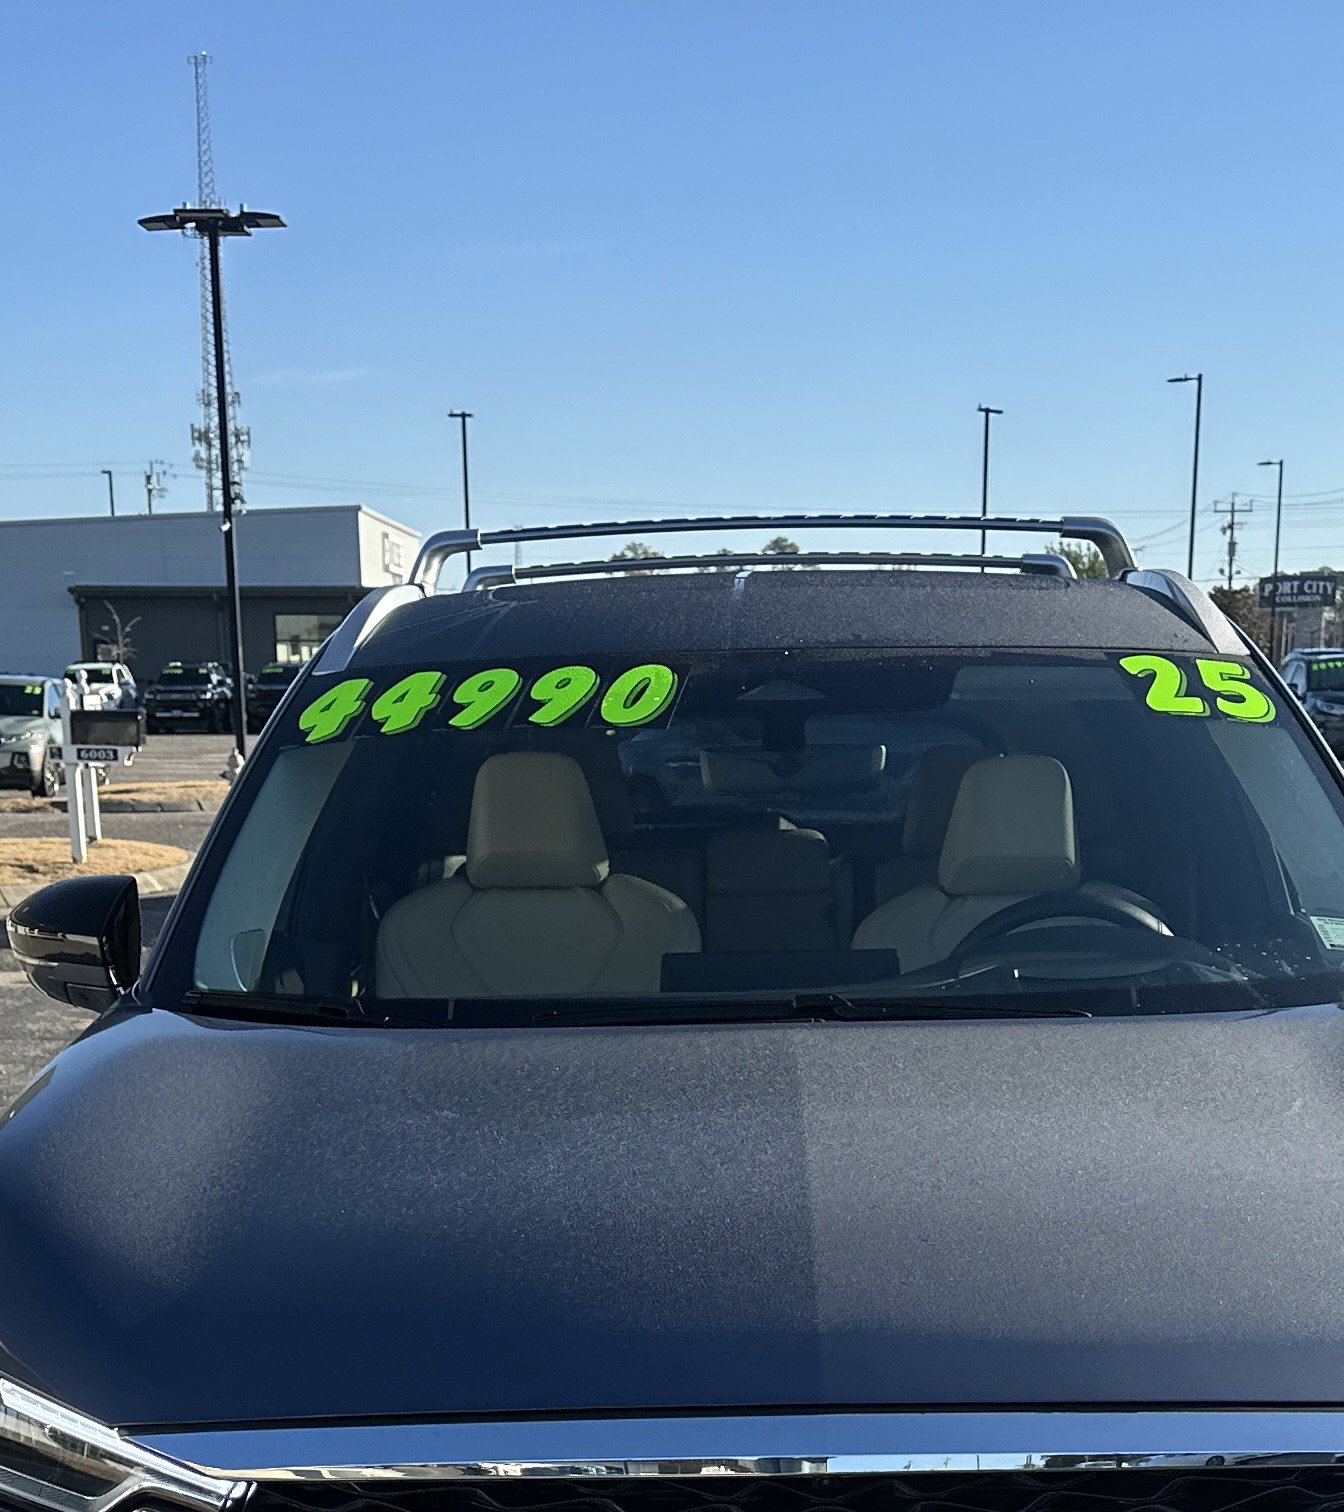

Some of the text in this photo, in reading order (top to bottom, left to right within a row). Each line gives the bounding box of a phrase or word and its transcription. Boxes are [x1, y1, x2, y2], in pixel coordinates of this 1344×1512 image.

[1304, 580, 1334, 594] CITY
[298, 664, 678, 744] 44990
[1119, 655, 1276, 723] 25
